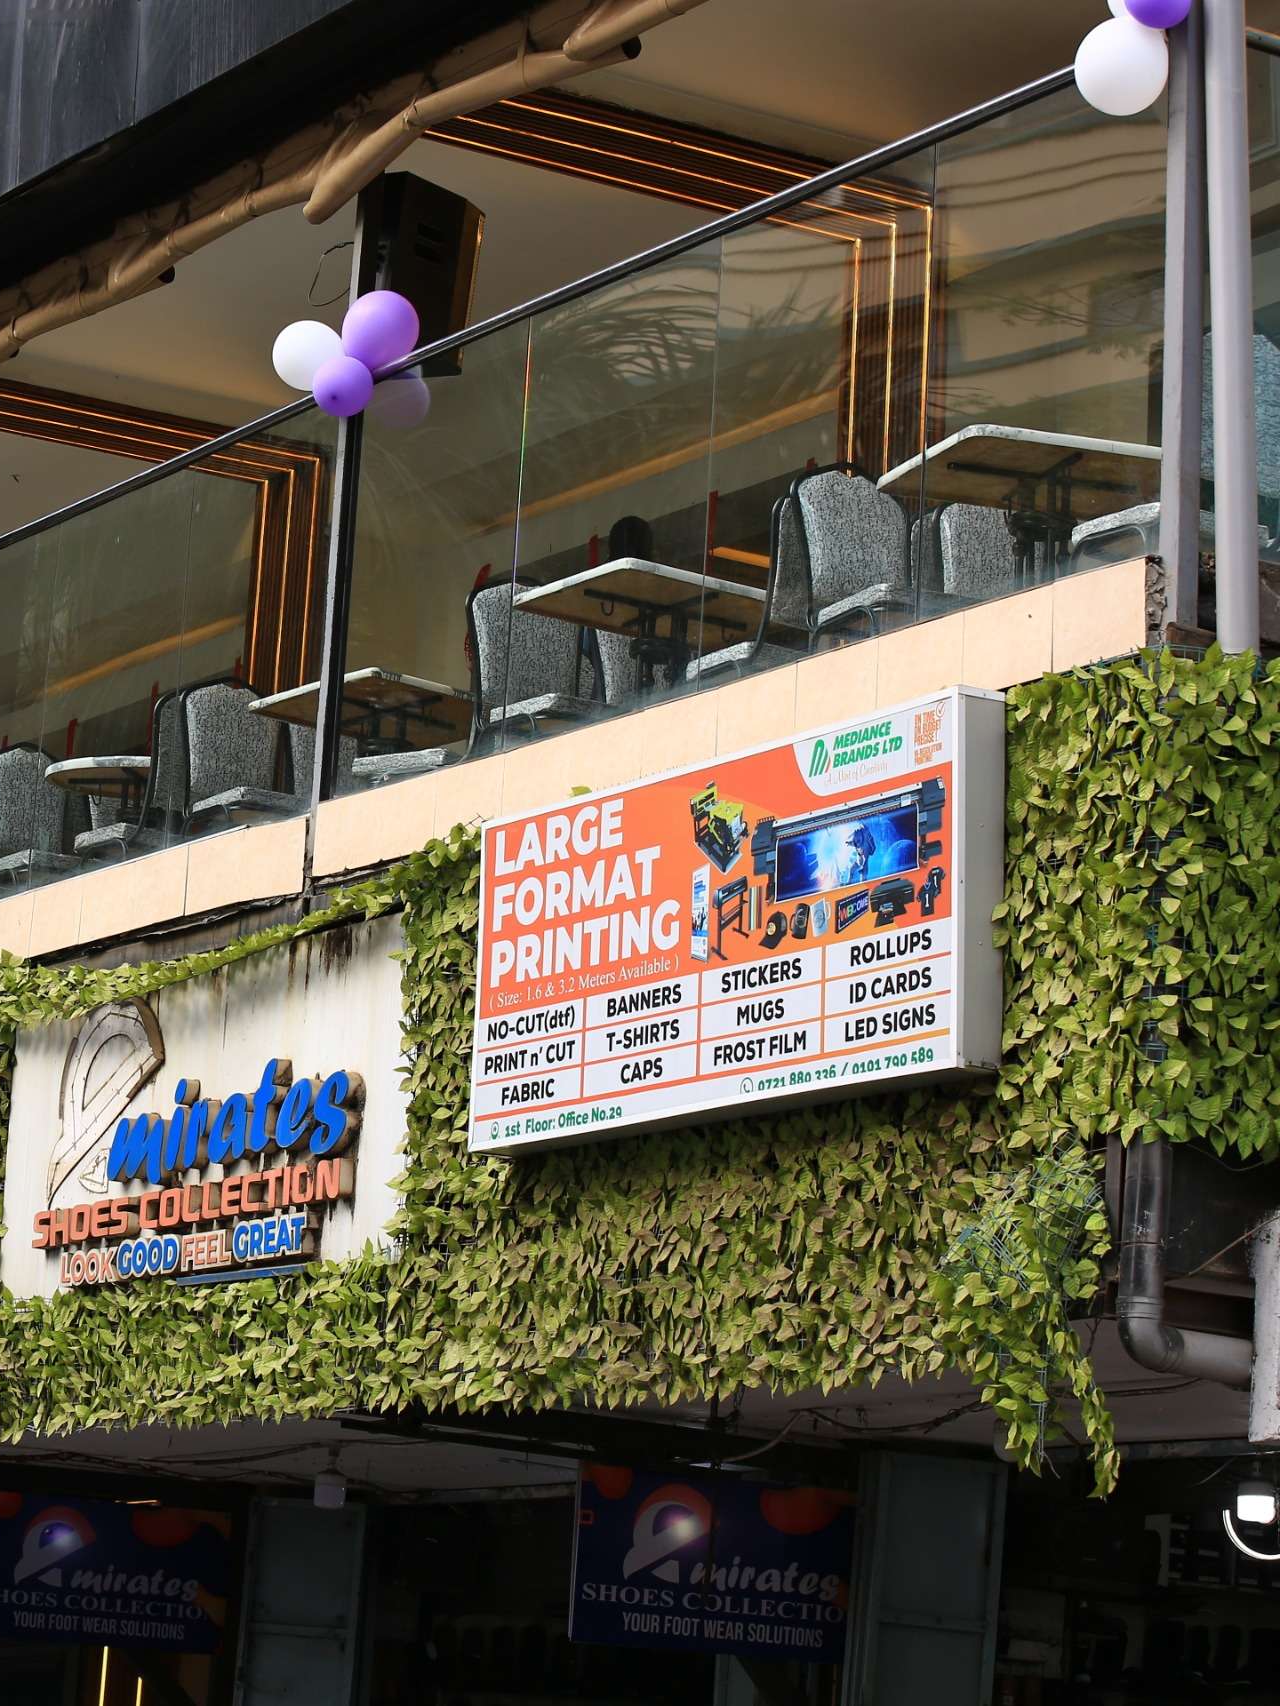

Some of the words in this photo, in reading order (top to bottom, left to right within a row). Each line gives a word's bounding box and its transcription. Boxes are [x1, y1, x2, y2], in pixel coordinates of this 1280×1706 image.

[832, 741, 880, 769] BRANDS
[882, 736, 903, 755] LTD
[833, 721, 892, 751] MEDIANCE
[494, 798, 624, 877] LARGE
[492, 845, 661, 933] FORMAT
[489, 899, 681, 988] PRINTING
[850, 928, 932, 967] ROLLUPS
[527, 984, 542, 1000] 1.6
[545, 983, 555, 998] &
[559, 977, 575, 994] 3.2
[579, 970, 616, 990] Meters
[620, 957, 671, 983] Available
[721, 957, 802, 994] STICKERS
[849, 982, 867, 1004] ID
[870, 966, 932, 999] CARDS
[606, 983, 682, 1018] BANNERS
[736, 998, 785, 1026] MUGS
[487, 1005, 576, 1042] NO-CUT(dtf)
[606, 1018, 680, 1052] T-SHIRTS
[844, 1016, 878, 1043] LED
[882, 1003, 936, 1035] SIGNS
[484, 1049, 527, 1076] PRINT
[546, 1040, 576, 1063] CUT
[713, 1039, 766, 1067] FROST
[769, 1030, 807, 1056] FILM
[852, 1058, 881, 1074] 0101
[910, 1046, 934, 1064] 589
[620, 1057, 663, 1084] CAPS
[501, 1079, 555, 1106] FABRIC
[505, 1121, 521, 1137] 1st
[525, 1117, 556, 1134] Floor:
[558, 1111, 589, 1128] Office
[32, 1195, 133, 1249] SHOES
[139, 1157, 350, 1230] COLLECTION
[59, 1246, 120, 1288] LOOK
[117, 1233, 180, 1276] GOOD
[181, 1229, 232, 1270] FEEL
[233, 1212, 308, 1263] GREAT
[581, 1582, 675, 1610] SHOES
[682, 1591, 846, 1624] COLLECTIO
[13, 1610, 47, 1630] YOUR
[48, 1612, 80, 1632] FOOT
[81, 1616, 117, 1635] WEAR
[120, 1619, 185, 1641] SOLUTIONS
[621, 1611, 661, 1634] YOUR
[663, 1614, 701, 1637] FOOT
[703, 1619, 743, 1641] WEAR
[747, 1623, 824, 1649] SOLUTIONS
